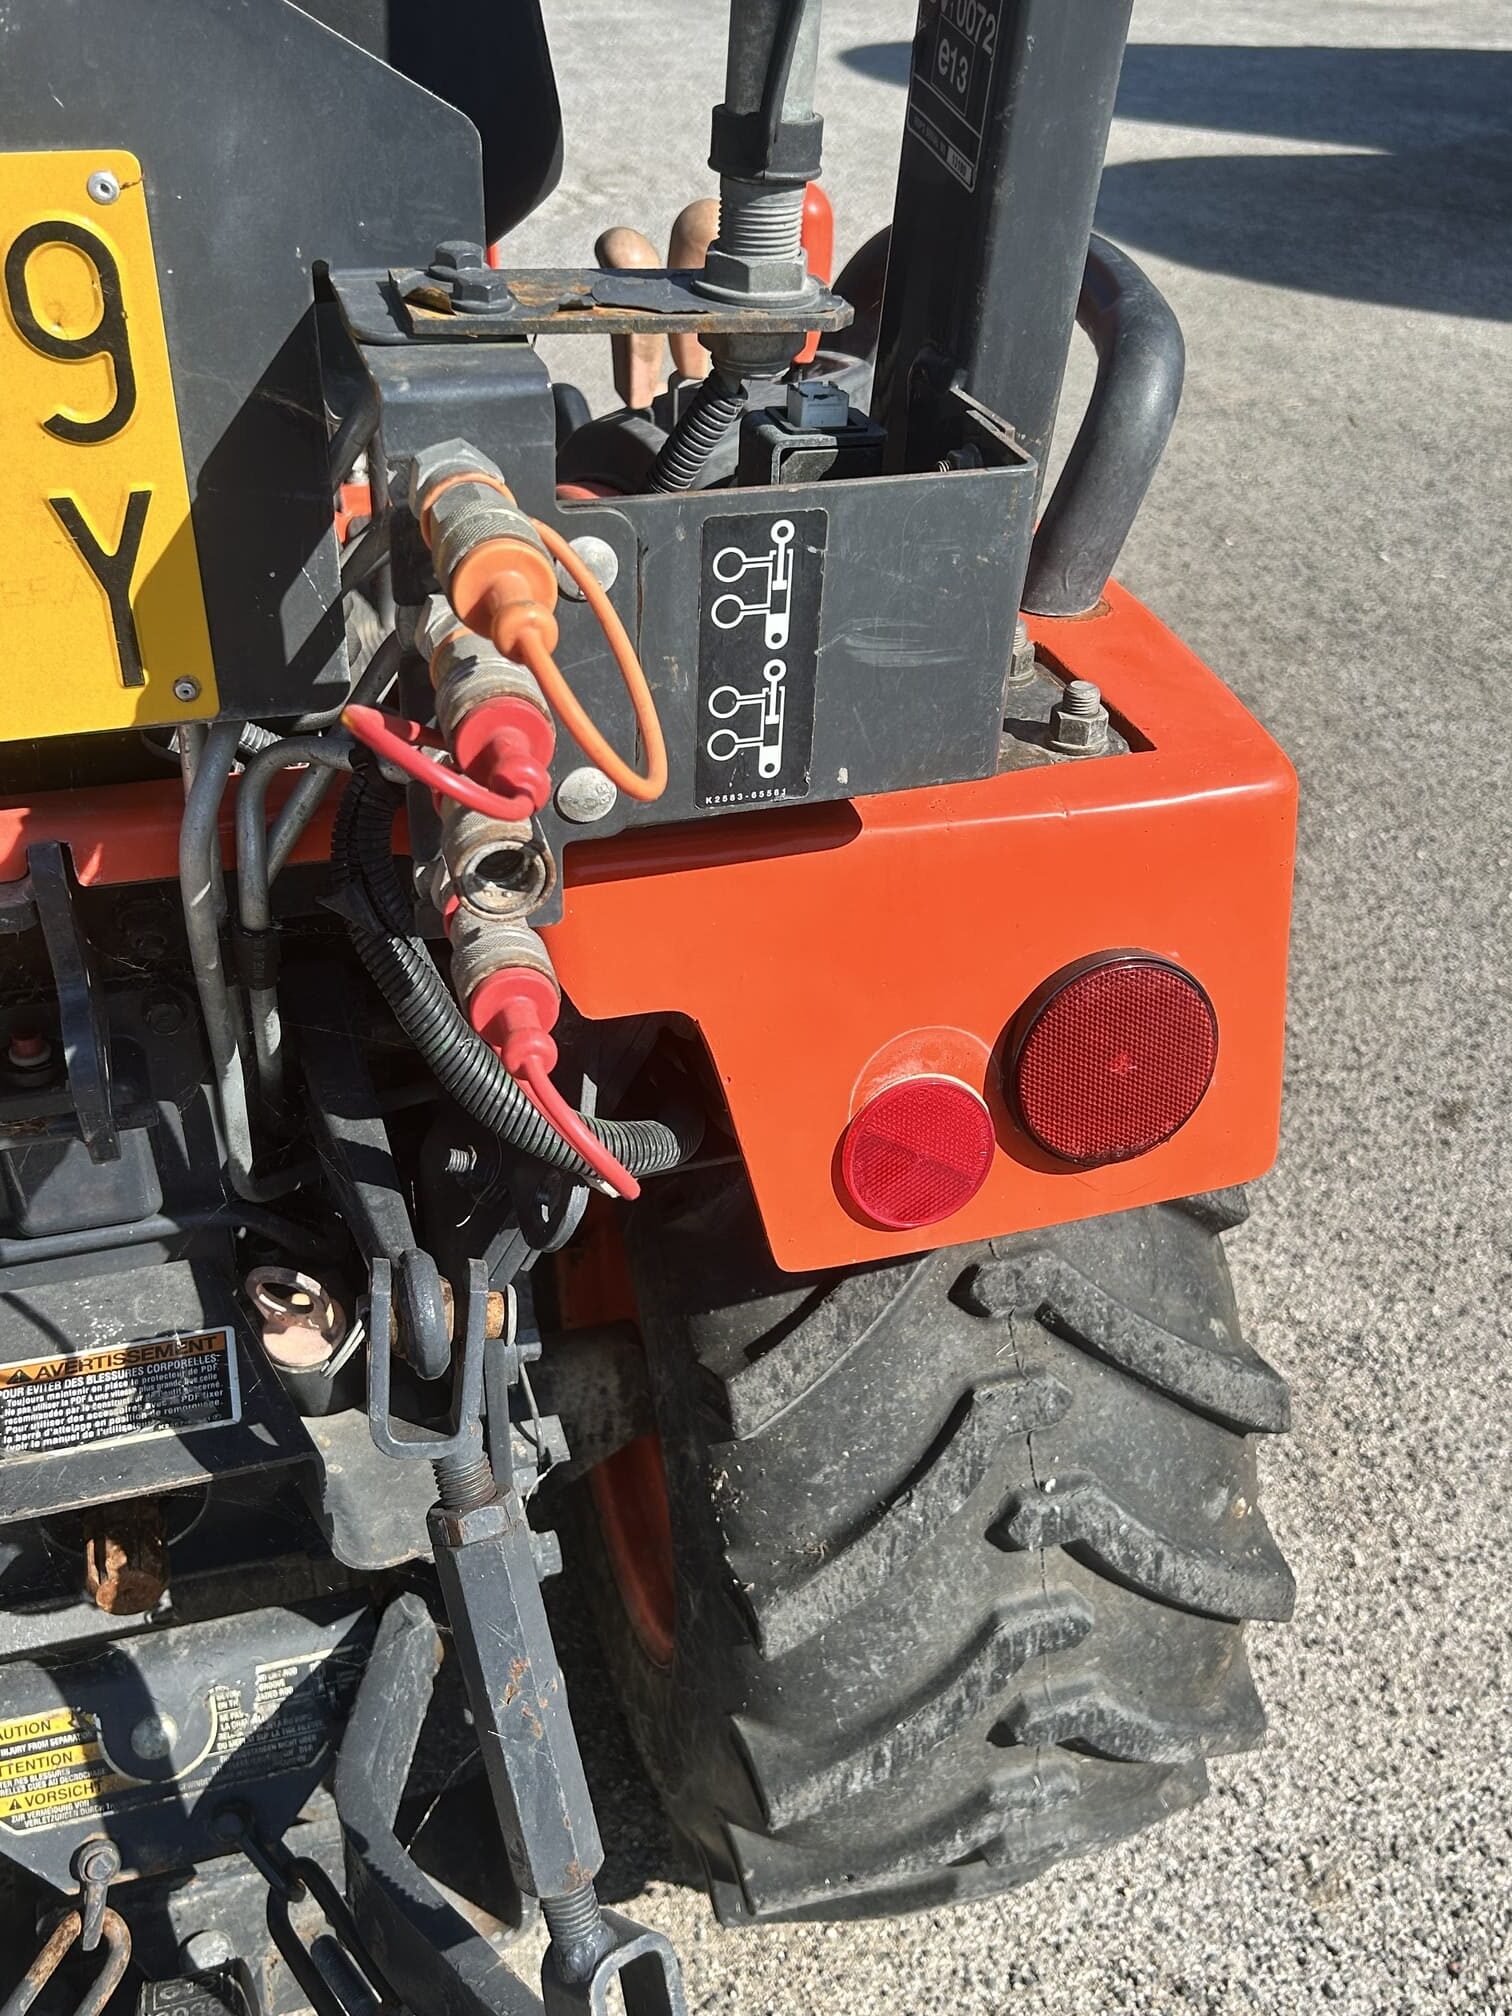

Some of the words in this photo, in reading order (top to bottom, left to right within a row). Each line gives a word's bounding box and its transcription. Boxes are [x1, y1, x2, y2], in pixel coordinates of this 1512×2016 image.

[938, 38, 968, 94] e13
[4, 220, 136, 443] 9
[49, 490, 152, 687] Y
[35, 1336, 217, 1380] AVERTISSEMENT
[6, 1395, 44, 1408] Toujours
[47, 1386, 89, 1401] maintenir
[91, 1383, 103, 1393] en
[188, 1367, 198, 1375] de
[64, 1377, 84, 1389] DES
[86, 1366, 144, 1386] BLESSURES
[4, 1407, 16, 1417] Ne
[17, 1405, 32, 1417] pas
[33, 1401, 60, 1413] utiliser
[61, 1399, 69, 1408] la
[70, 1395, 86, 1405] PDF
[95, 1392, 110, 1401] une
[4, 1409, 64, 1426] recommandée
[65, 1404, 80, 1416] par
[5, 1423, 29, 1435] Pour
[30, 1417, 65, 1432] utiliser
[67, 1413, 85, 1424] des
[43, 1421, 92, 1438] d'attelage
[94, 1418, 107, 1428] en
[31, 1438, 40, 1448] le
[42, 1432, 80, 1447] manuel
[82, 1429, 94, 1440] de
[28, 1741, 49, 1753] FROM
[24, 1780, 101, 1807] VORSICHT
